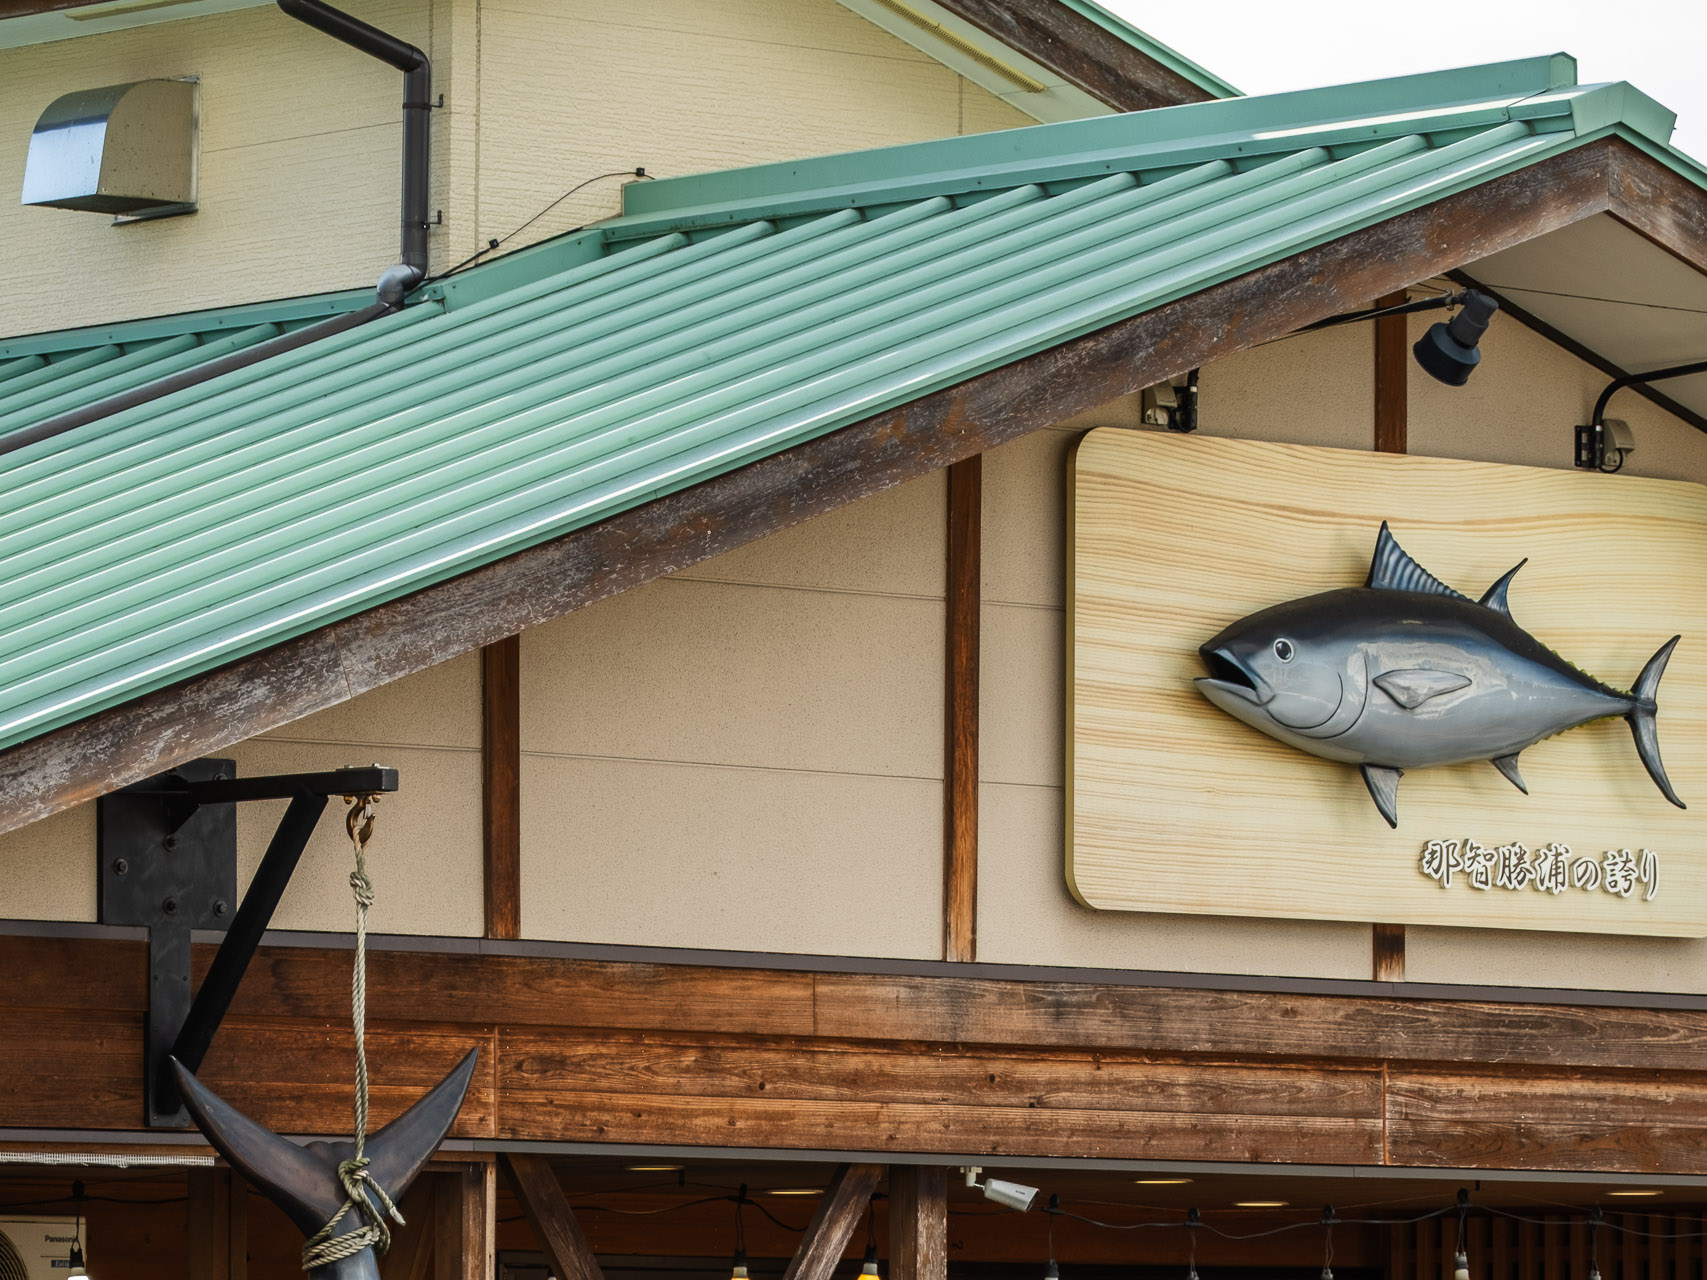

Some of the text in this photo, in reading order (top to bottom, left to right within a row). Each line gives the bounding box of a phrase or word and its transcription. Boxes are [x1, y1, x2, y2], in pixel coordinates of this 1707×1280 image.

[1419, 838, 1660, 901] 那智勝浦の誇り
